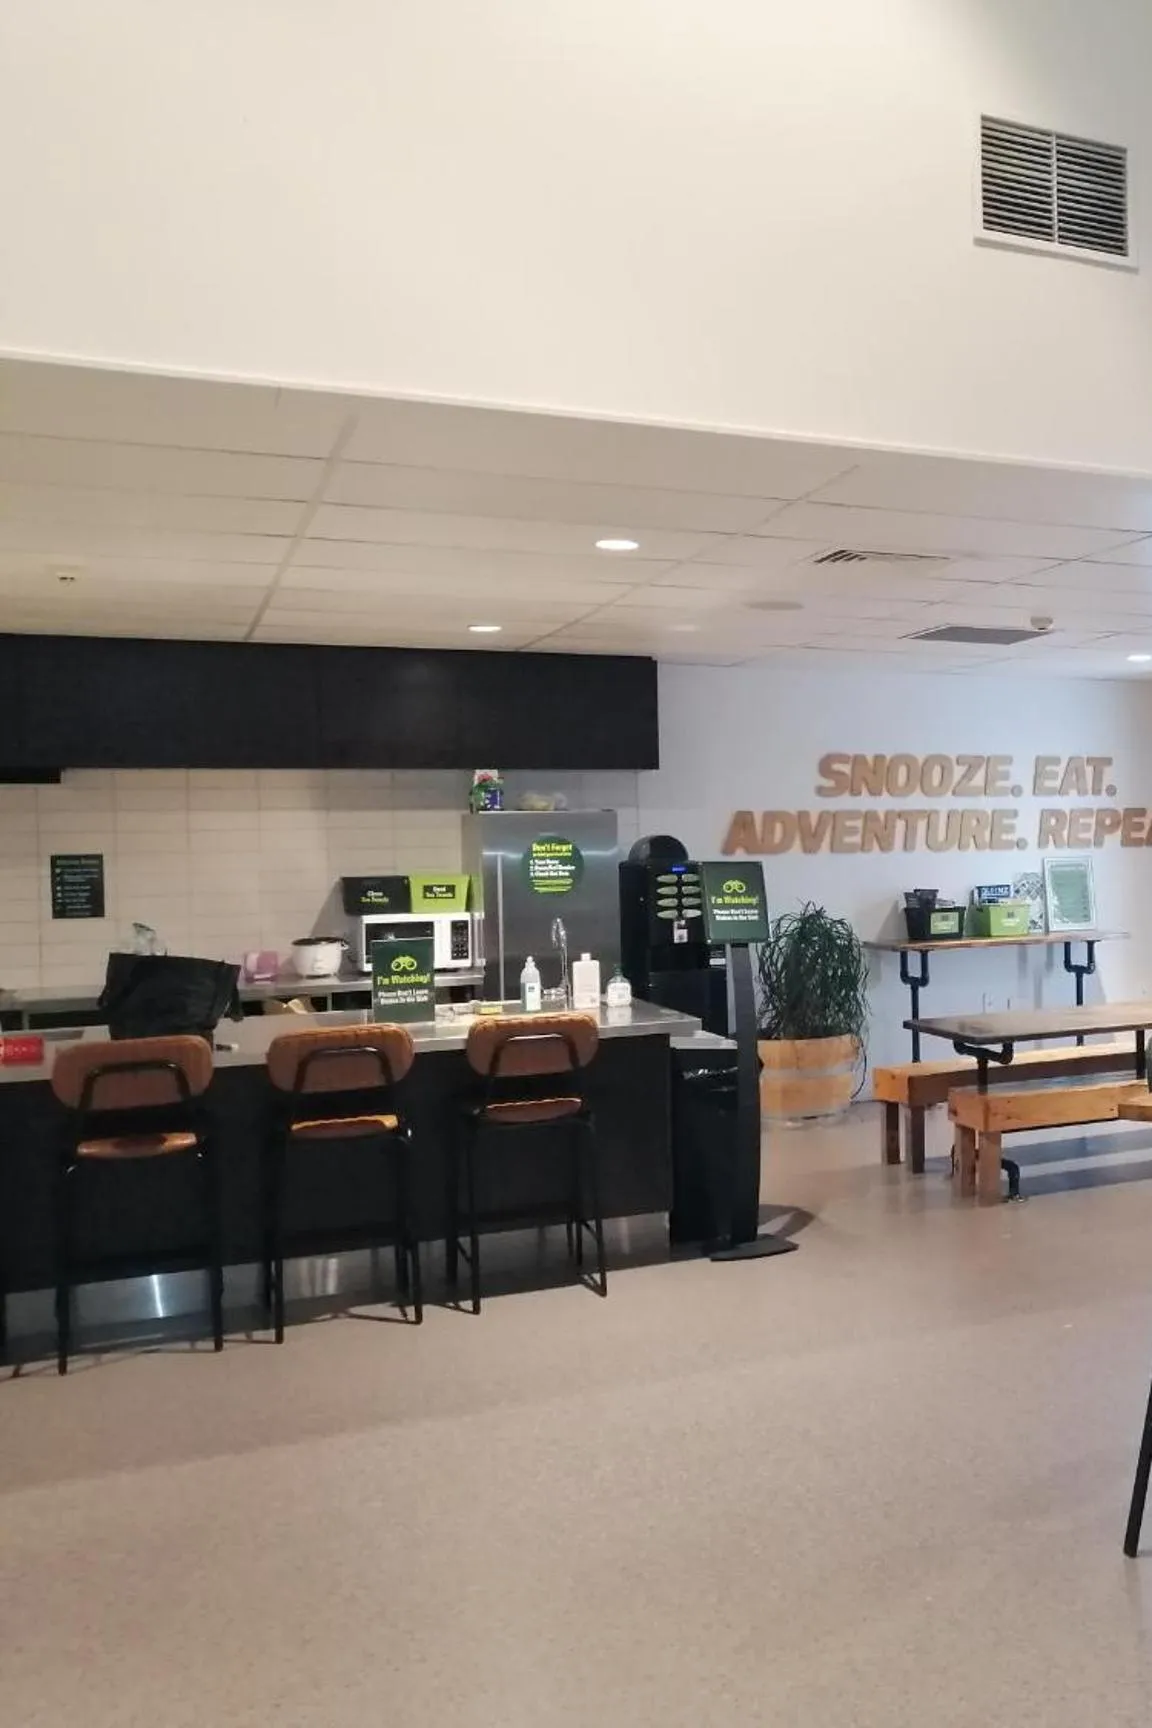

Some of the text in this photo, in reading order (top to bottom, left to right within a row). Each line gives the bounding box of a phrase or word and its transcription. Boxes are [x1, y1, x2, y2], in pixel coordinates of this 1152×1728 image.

[815, 753, 1118, 798] SNOOZE. EAT.
[721, 807, 1029, 856] ADVENTURE.
[551, 843, 573, 852] Forget
[711, 895, 760, 906] I'm Watching!
[377, 973, 432, 986] I'm Watching!
